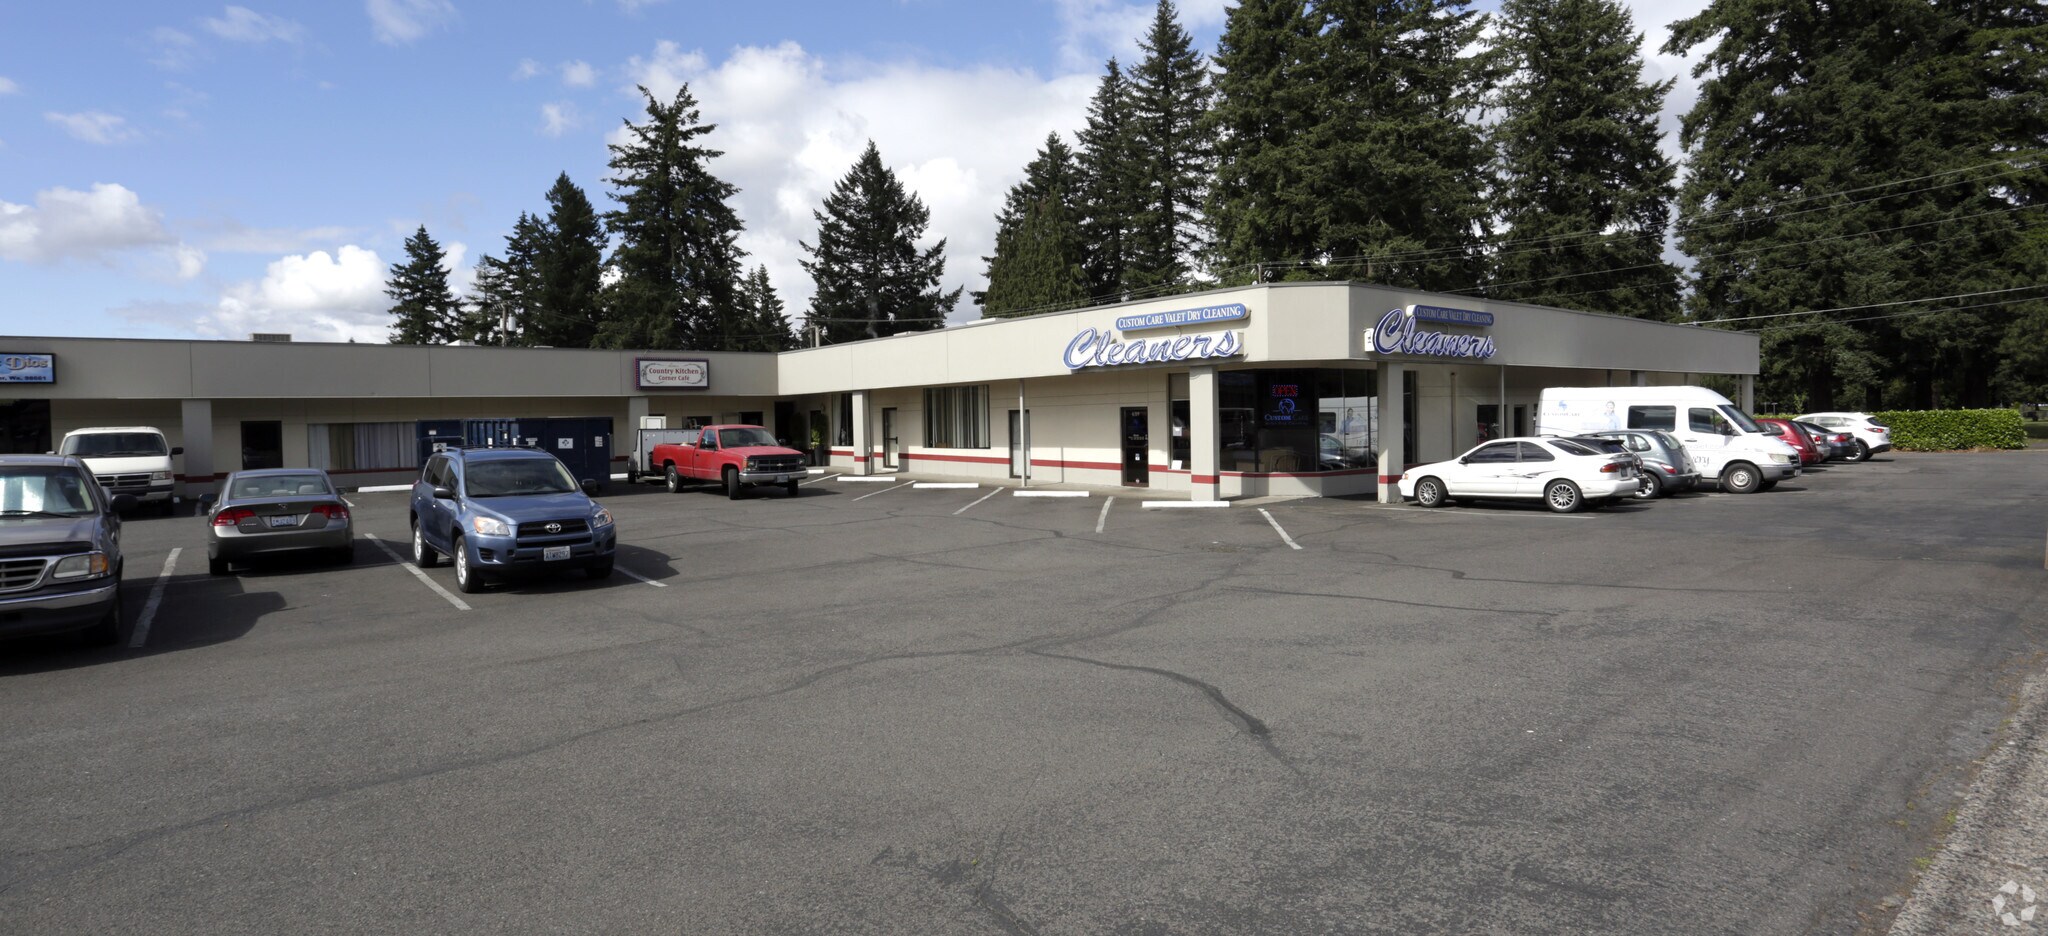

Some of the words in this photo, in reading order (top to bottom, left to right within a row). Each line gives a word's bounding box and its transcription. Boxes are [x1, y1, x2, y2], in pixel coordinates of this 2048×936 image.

[1118, 316, 1146, 329] CUSTOM
[1146, 314, 1164, 326] CARE
[1164, 311, 1186, 323] VALET
[1187, 308, 1201, 321] DRY
[1202, 305, 1241, 319] CLEANING
[1416, 307, 1437, 319] CUSTOM
[1436, 308, 1449, 320] CARE
[1448, 309, 1463, 321] VALET
[1463, 311, 1472, 322] DRY
[1471, 312, 1493, 325] CLEANING
[1373, 308, 1497, 359] Cleaners
[1063, 327, 1243, 370] Cleaners
[648, 367, 674, 375] Country
[675, 367, 699, 375] Kitchen
[1274, 386, 1297, 395] OPEN
